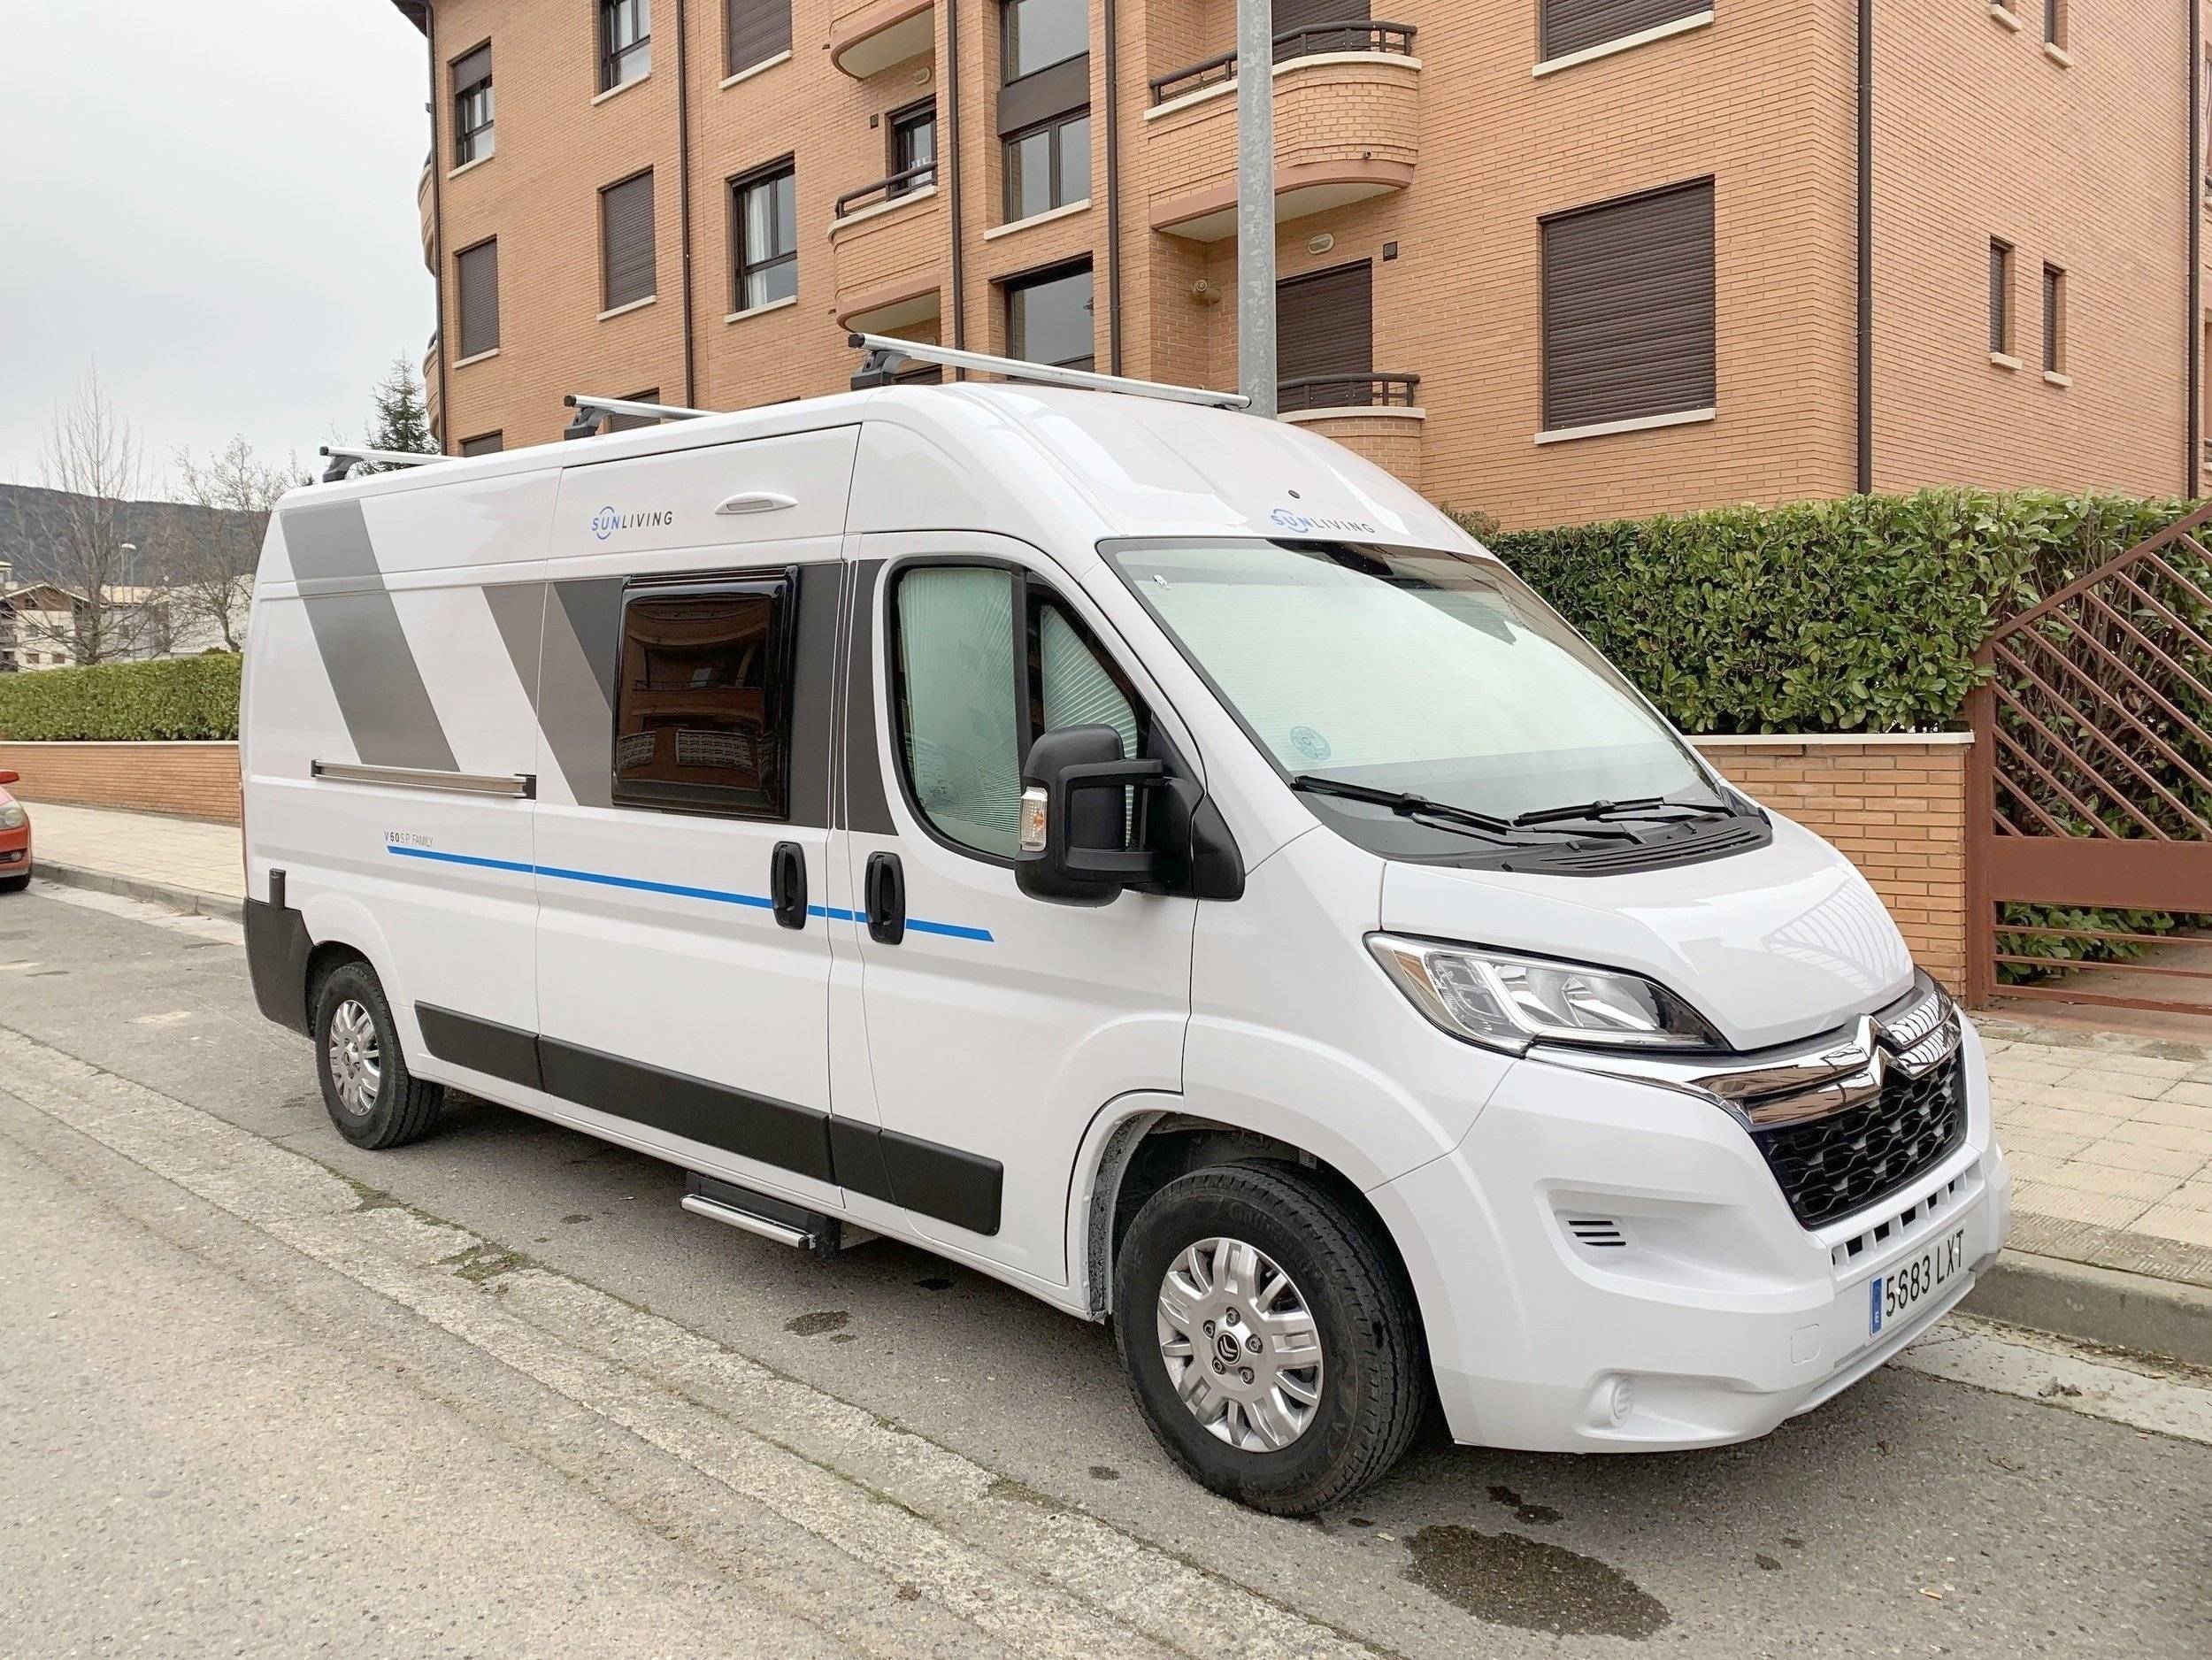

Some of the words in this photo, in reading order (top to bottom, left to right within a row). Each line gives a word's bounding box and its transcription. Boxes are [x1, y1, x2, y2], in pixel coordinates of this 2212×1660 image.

[592, 511, 673, 532] SUNLIVING
[1886, 1255, 1931, 1317] 5683
[1937, 1229, 1964, 1285] LXT
